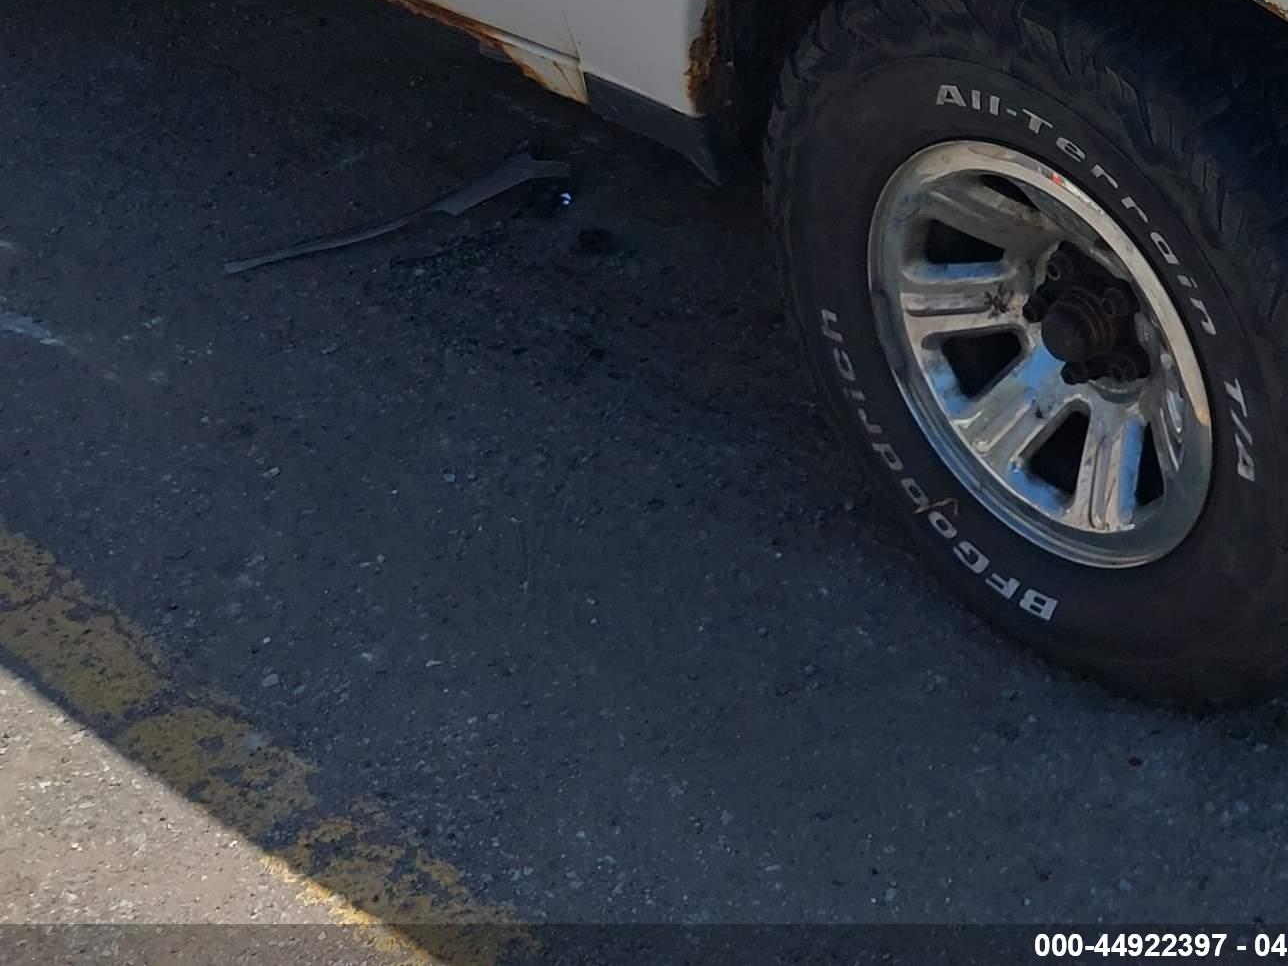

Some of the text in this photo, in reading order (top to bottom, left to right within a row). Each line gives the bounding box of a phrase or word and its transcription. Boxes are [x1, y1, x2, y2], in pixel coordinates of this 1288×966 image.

[935, 84, 1256, 482] All-Terrain T/A
[820, 308, 1059, 622] BFGoodrich
